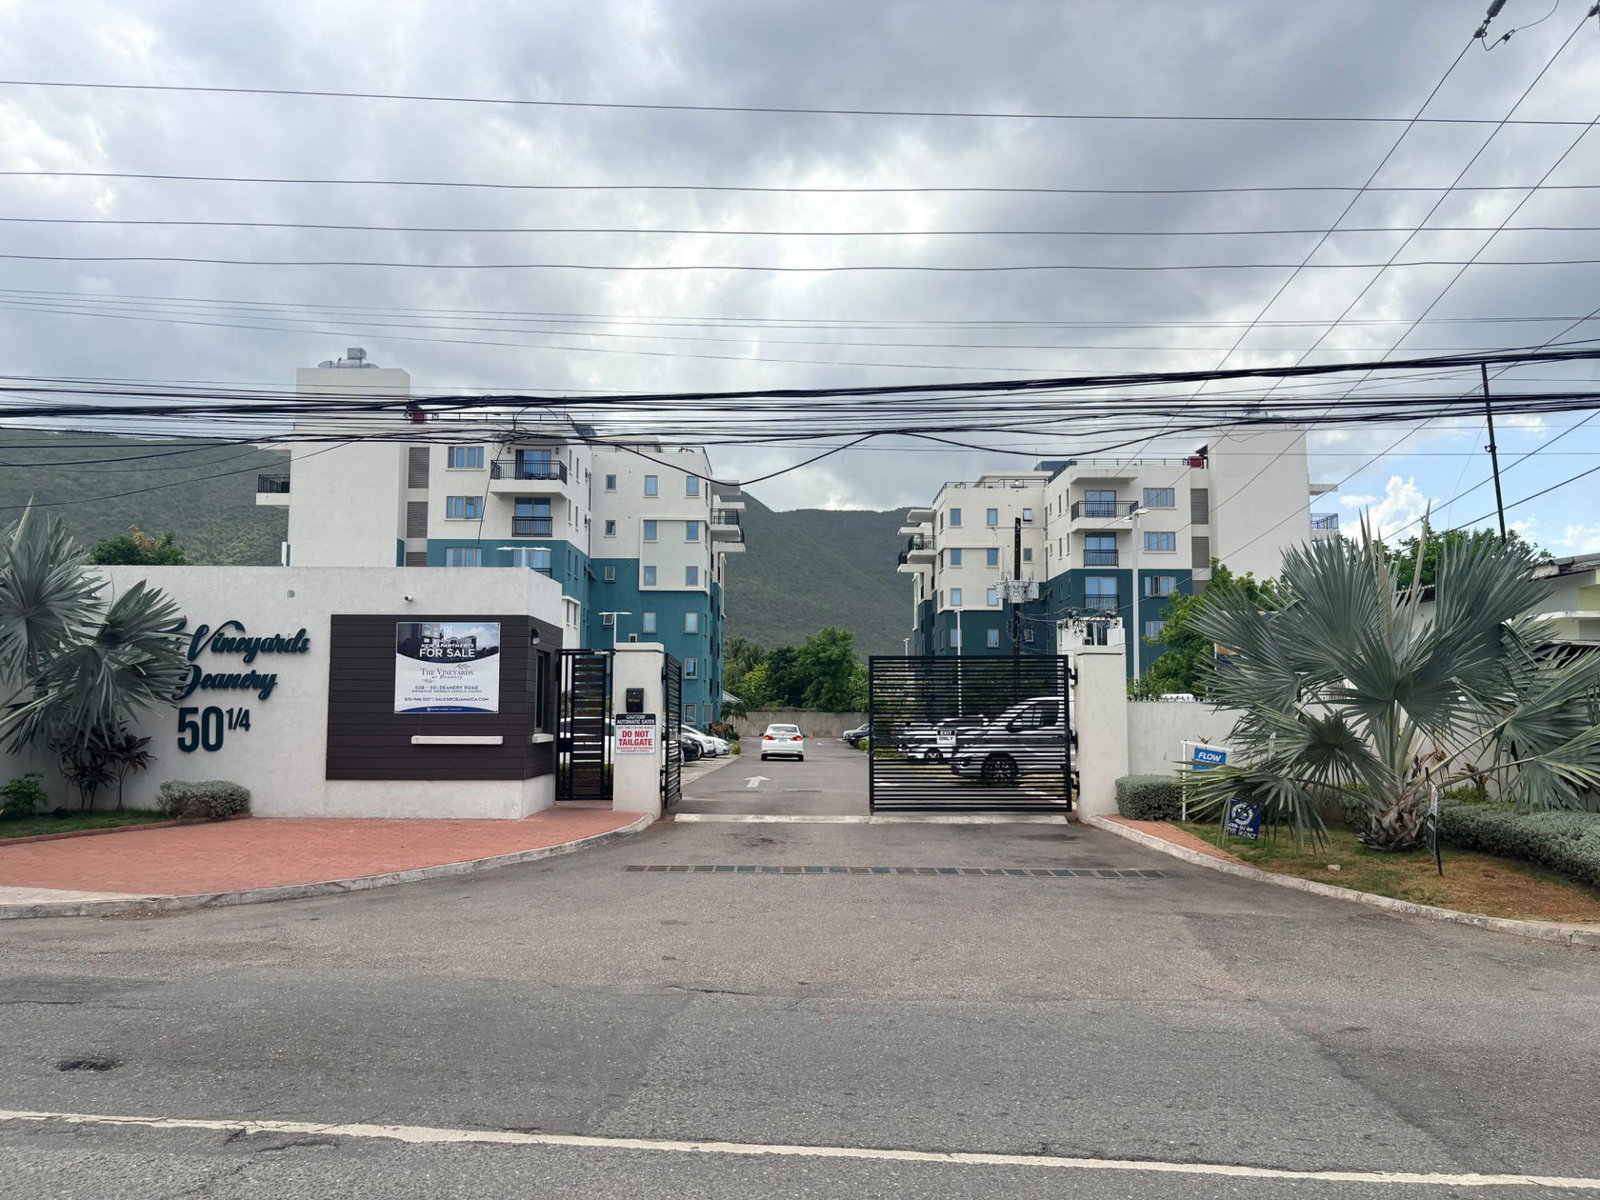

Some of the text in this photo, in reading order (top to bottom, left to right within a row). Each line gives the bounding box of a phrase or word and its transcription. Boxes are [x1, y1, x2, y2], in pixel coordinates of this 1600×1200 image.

[187, 620, 311, 663] Vineyards
[420, 648, 475, 658] FOR SALE
[1198, 752, 1222, 762] FLOW
